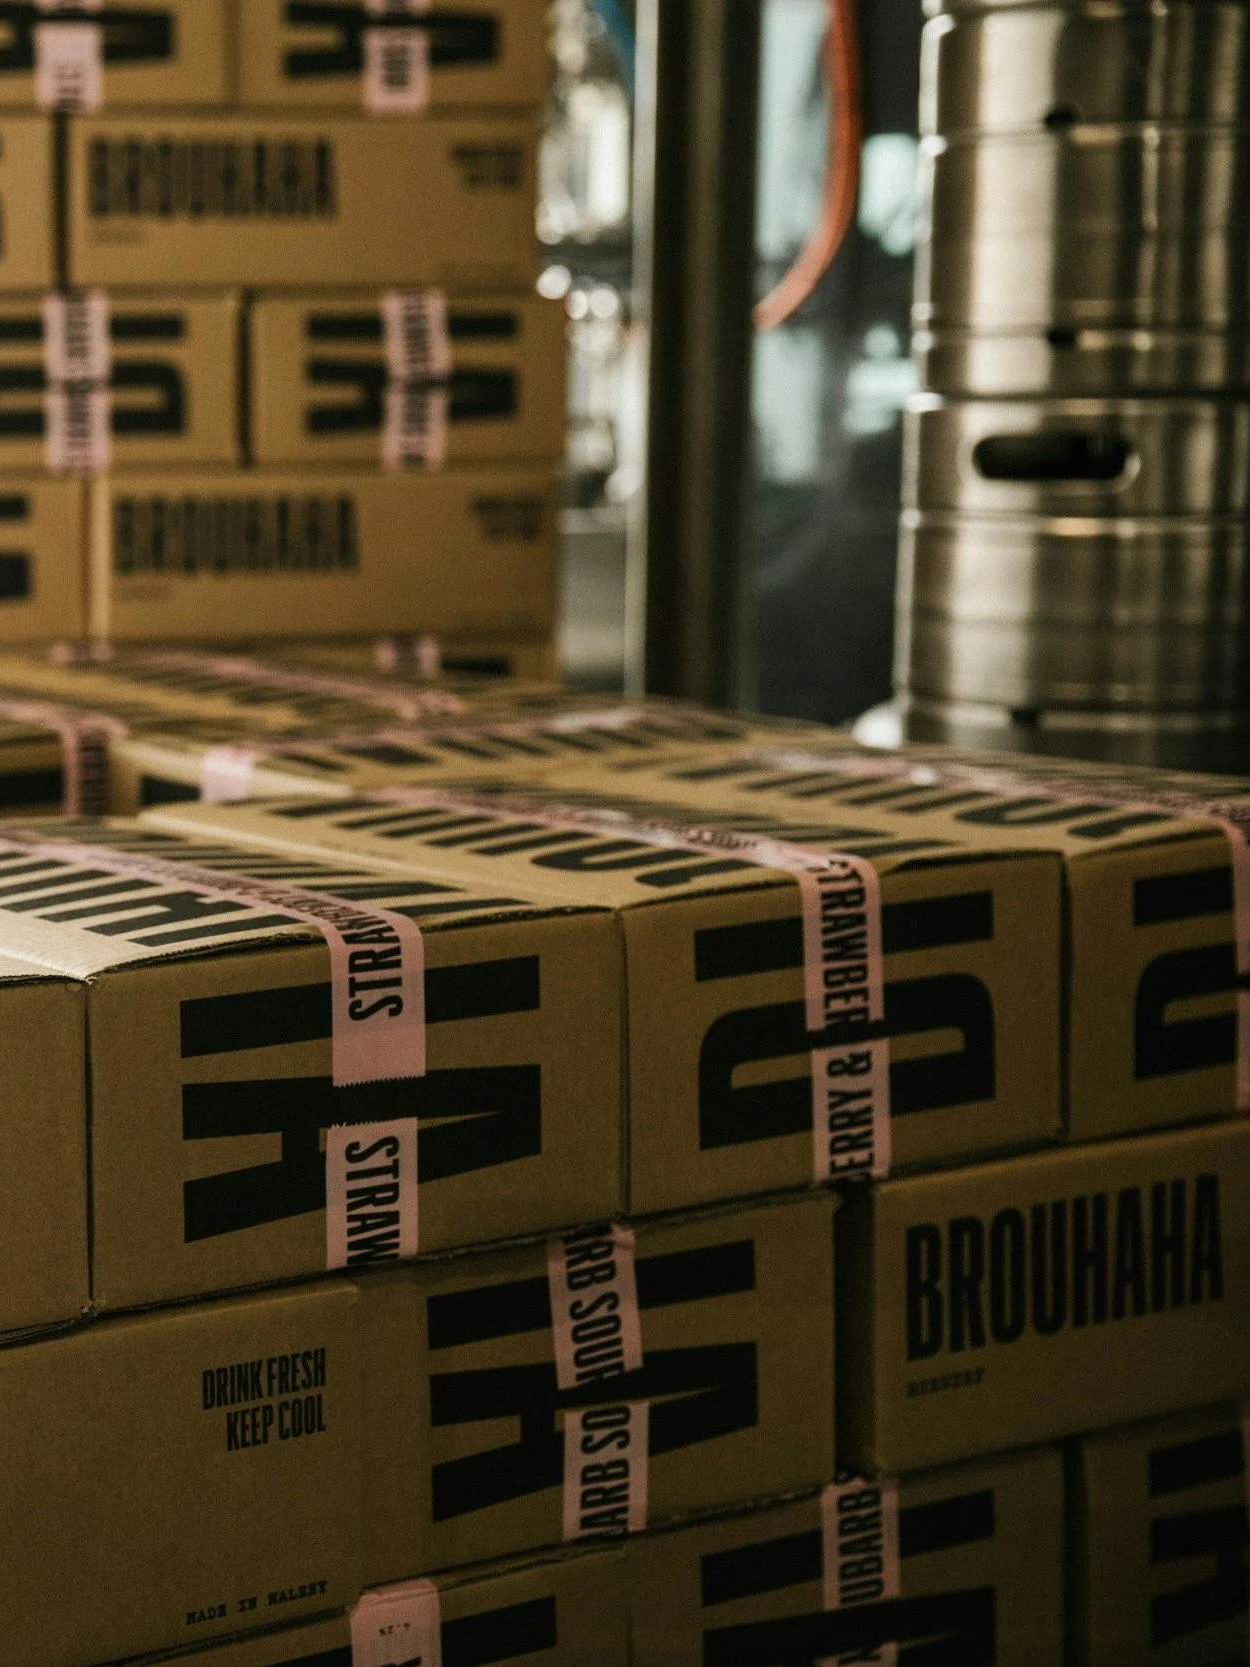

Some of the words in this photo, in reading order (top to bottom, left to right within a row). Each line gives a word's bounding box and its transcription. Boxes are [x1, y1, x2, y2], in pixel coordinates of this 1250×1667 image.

[826, 1049, 873, 1079] &
[828, 1089, 874, 1183] ERRY
[344, 1135, 401, 1264] STRAW
[905, 1173, 1224, 1363] BROUHAHA
[202, 1360, 264, 1410] DRINK
[266, 1347, 327, 1397] FRESH
[226, 1404, 274, 1452] KEEP
[278, 1393, 327, 1441] COOL
[579, 1457, 630, 1539] ARB
